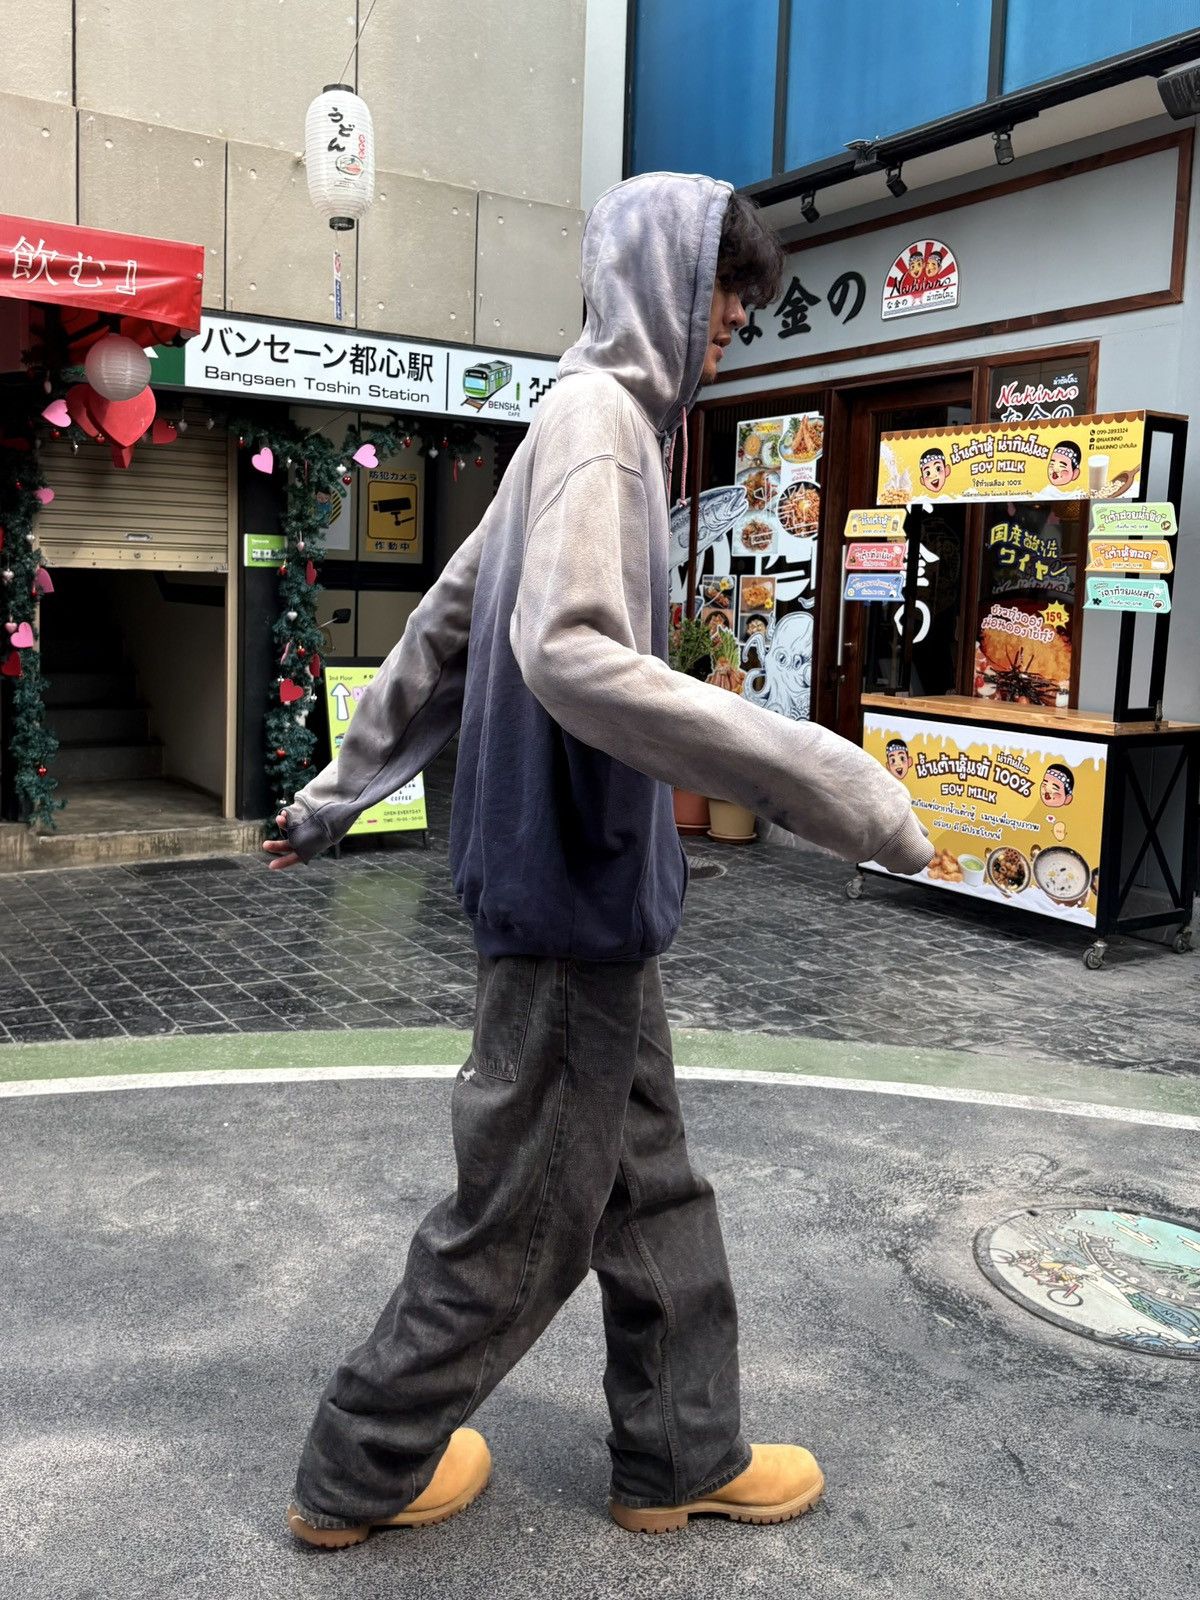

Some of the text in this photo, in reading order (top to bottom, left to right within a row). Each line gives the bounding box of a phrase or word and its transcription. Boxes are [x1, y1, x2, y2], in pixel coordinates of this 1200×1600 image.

[327, 106, 355, 153] うどん
[887, 299, 909, 310] な金の
[201, 327, 433, 384] バンセーン都心駅
[205, 366, 430, 403] Bangsaen Toshin Station
[996, 381, 1079, 408] Nakinno
[488, 400, 521, 412] BENSHA
[971, 460, 1025, 475] SOY MILK
[941, 783, 997, 804] SOY MILK
[993, 763, 1035, 797] 100%
